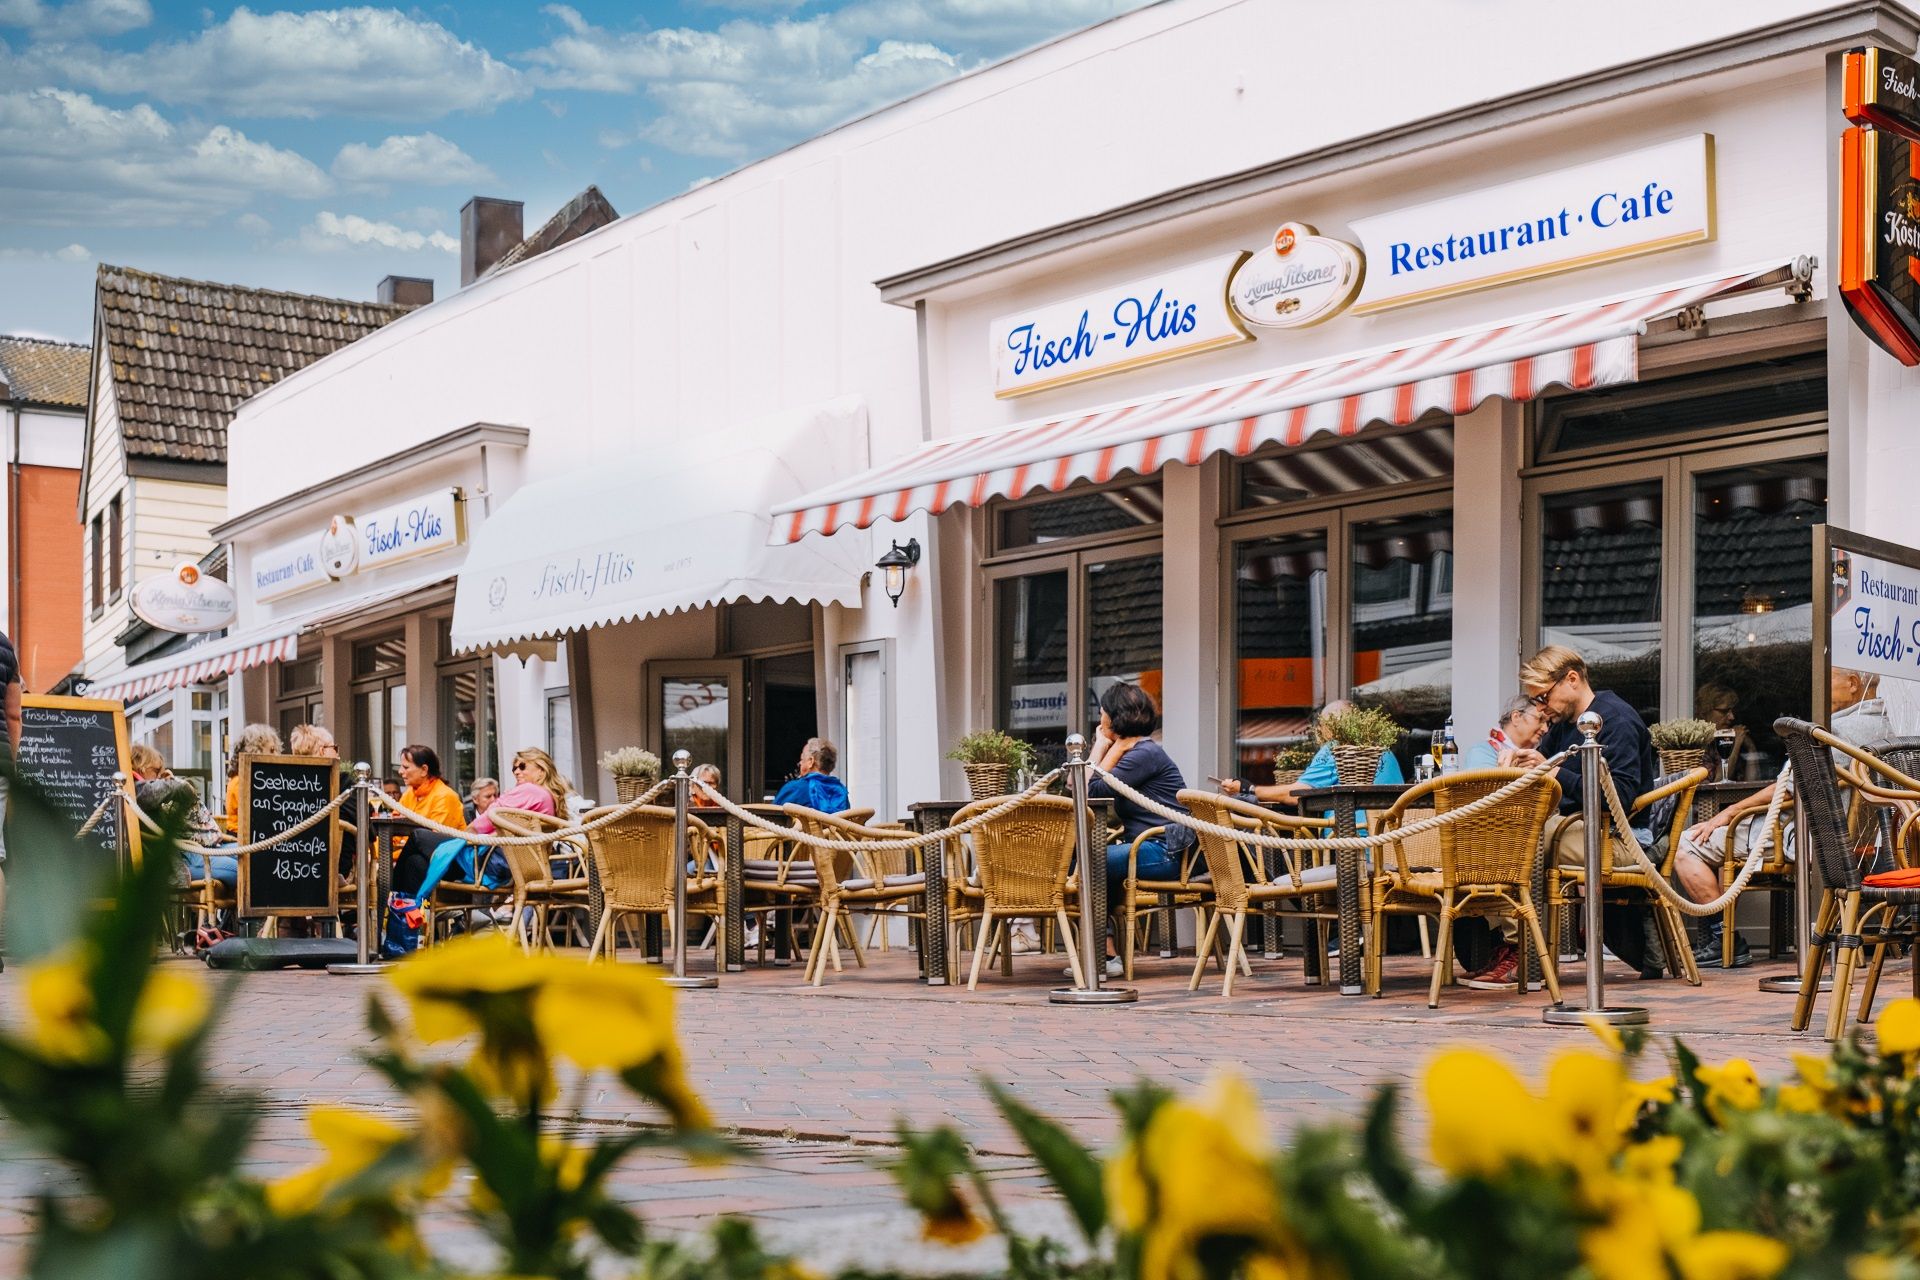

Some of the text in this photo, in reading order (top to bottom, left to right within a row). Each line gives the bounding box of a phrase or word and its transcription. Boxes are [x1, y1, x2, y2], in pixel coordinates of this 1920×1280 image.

[1390, 182, 1673, 276] Restaurant Cafe
[256, 553, 314, 588] Restaurant Cafe
[1861, 570, 1918, 606] Restaurant
[253, 770, 323, 792] Seehecht
[253, 798, 271, 810] an
[272, 858, 321, 881] 18,50€
